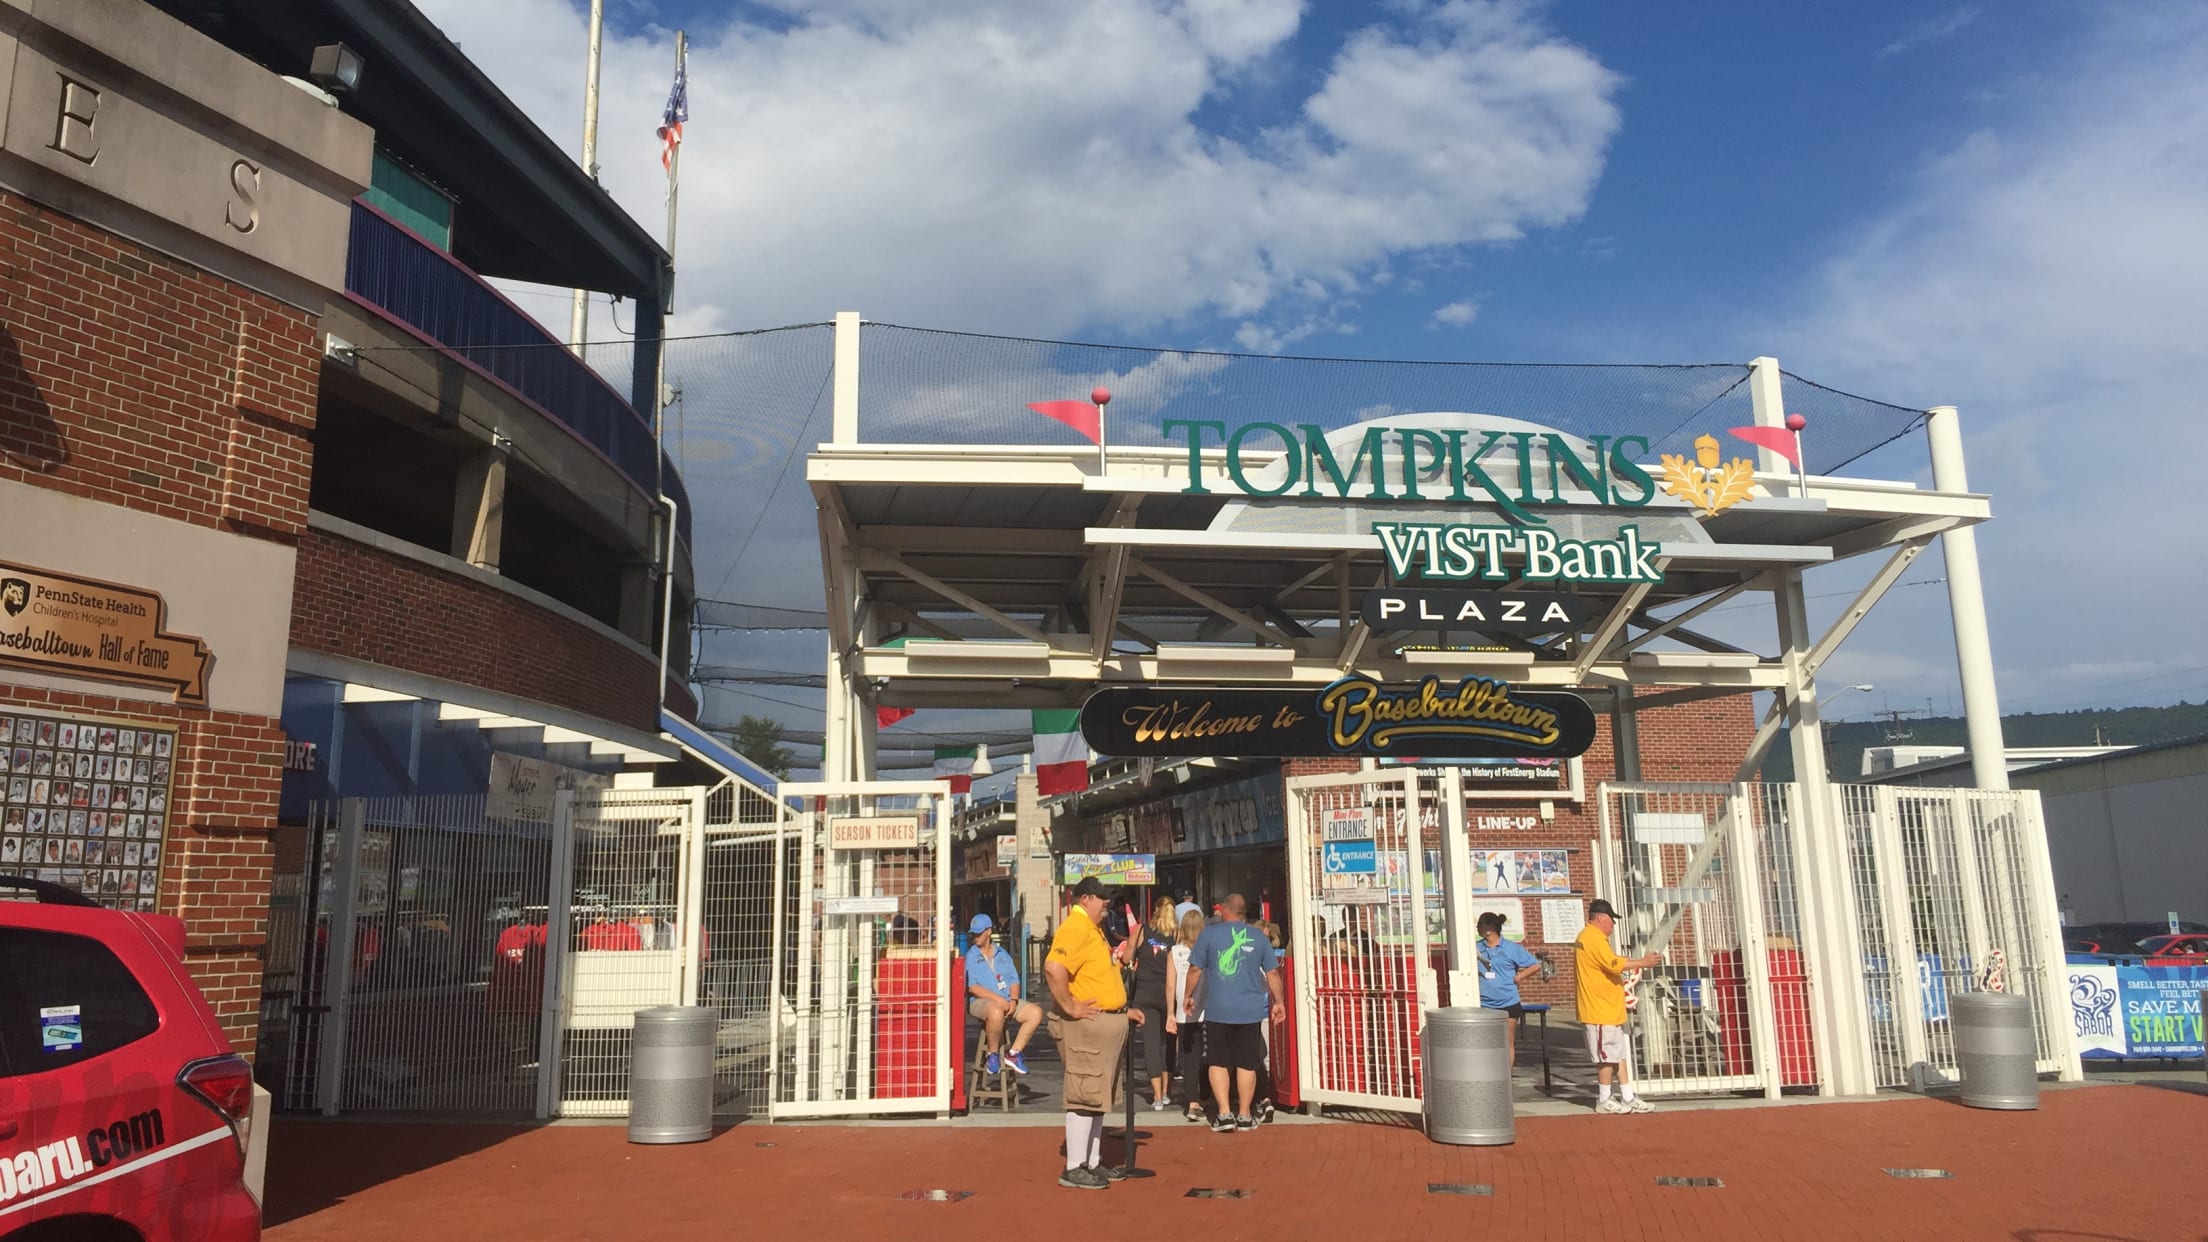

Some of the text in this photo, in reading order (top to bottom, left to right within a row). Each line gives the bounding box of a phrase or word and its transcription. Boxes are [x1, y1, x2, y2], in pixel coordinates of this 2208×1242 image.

[1163, 418, 1656, 524] TOMPKINS
[1373, 522, 1664, 583] VIST Bank
[33, 602, 119, 628] Children's Hospital
[106, 598, 147, 617] Health
[1380, 599, 1571, 622] PLAZA
[99, 633, 123, 663] Hall
[124, 646, 136, 664] of
[137, 640, 170, 670] Fame
[1122, 676, 1561, 748] Welcome to Baseballtown
[1461, 767, 1472, 777] the
[1472, 767, 1494, 779] History
[1494, 767, 1501, 777] of
[1502, 767, 1535, 779] FirstEnergy
[1535, 767, 1560, 777] Stadium
[835, 824, 915, 841] SEASON TICKETS
[1328, 819, 1368, 839] ENTRANCE
[1477, 815, 1537, 830] LINE-UP
[1341, 850, 1375, 861] ENTRANCE
[2127, 981, 2156, 989] SMELL
[2160, 989, 2200, 998] FEEL BET
[2128, 1000, 2201, 1014] SAVE M
[2074, 1011, 2114, 1037] SABOR
[2130, 1016, 2185, 1043] START
[2191, 1015, 2204, 1042] V
